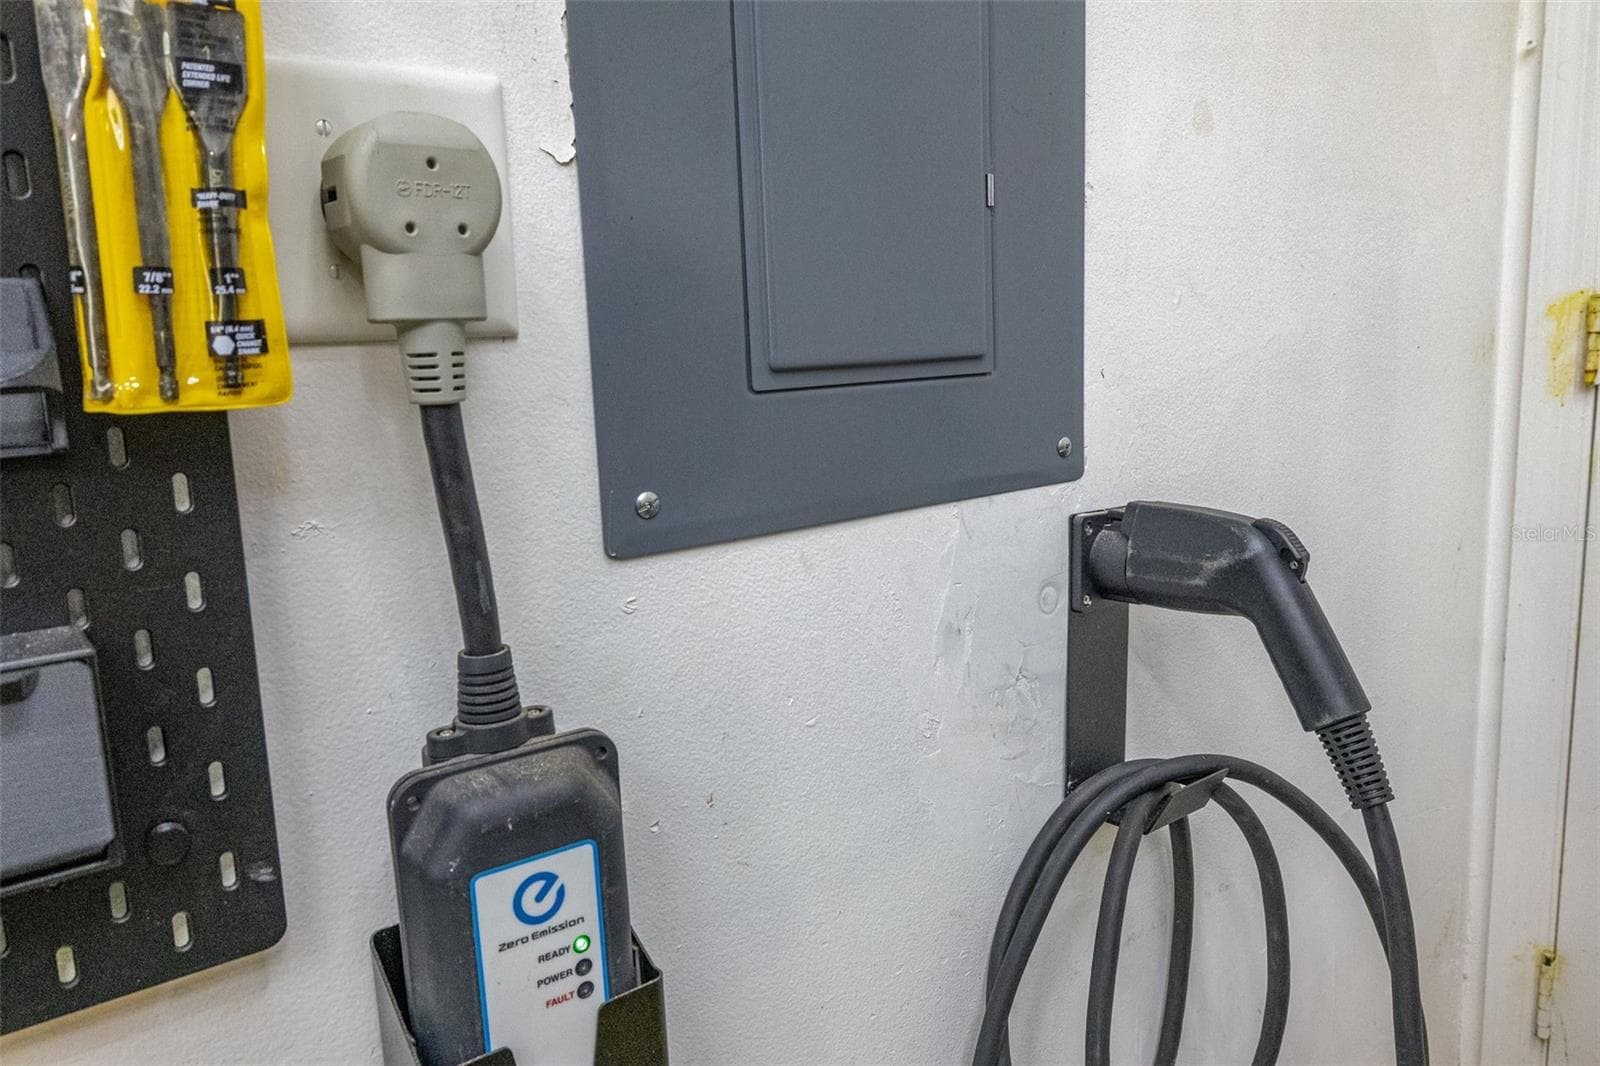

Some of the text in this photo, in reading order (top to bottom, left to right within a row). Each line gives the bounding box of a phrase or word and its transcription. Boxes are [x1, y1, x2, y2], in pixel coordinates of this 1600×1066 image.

[181, 62, 215, 72] PATENTED
[182, 71, 231, 83] EXTENDED LIFE
[138, 284, 160, 294] 22.2
[214, 285, 235, 294] 25.4
[498, 916, 585, 953] Zero Emission
[538, 945, 571, 964] READY
[537, 968, 573, 988] POWER
[545, 990, 575, 1008] FAULT
